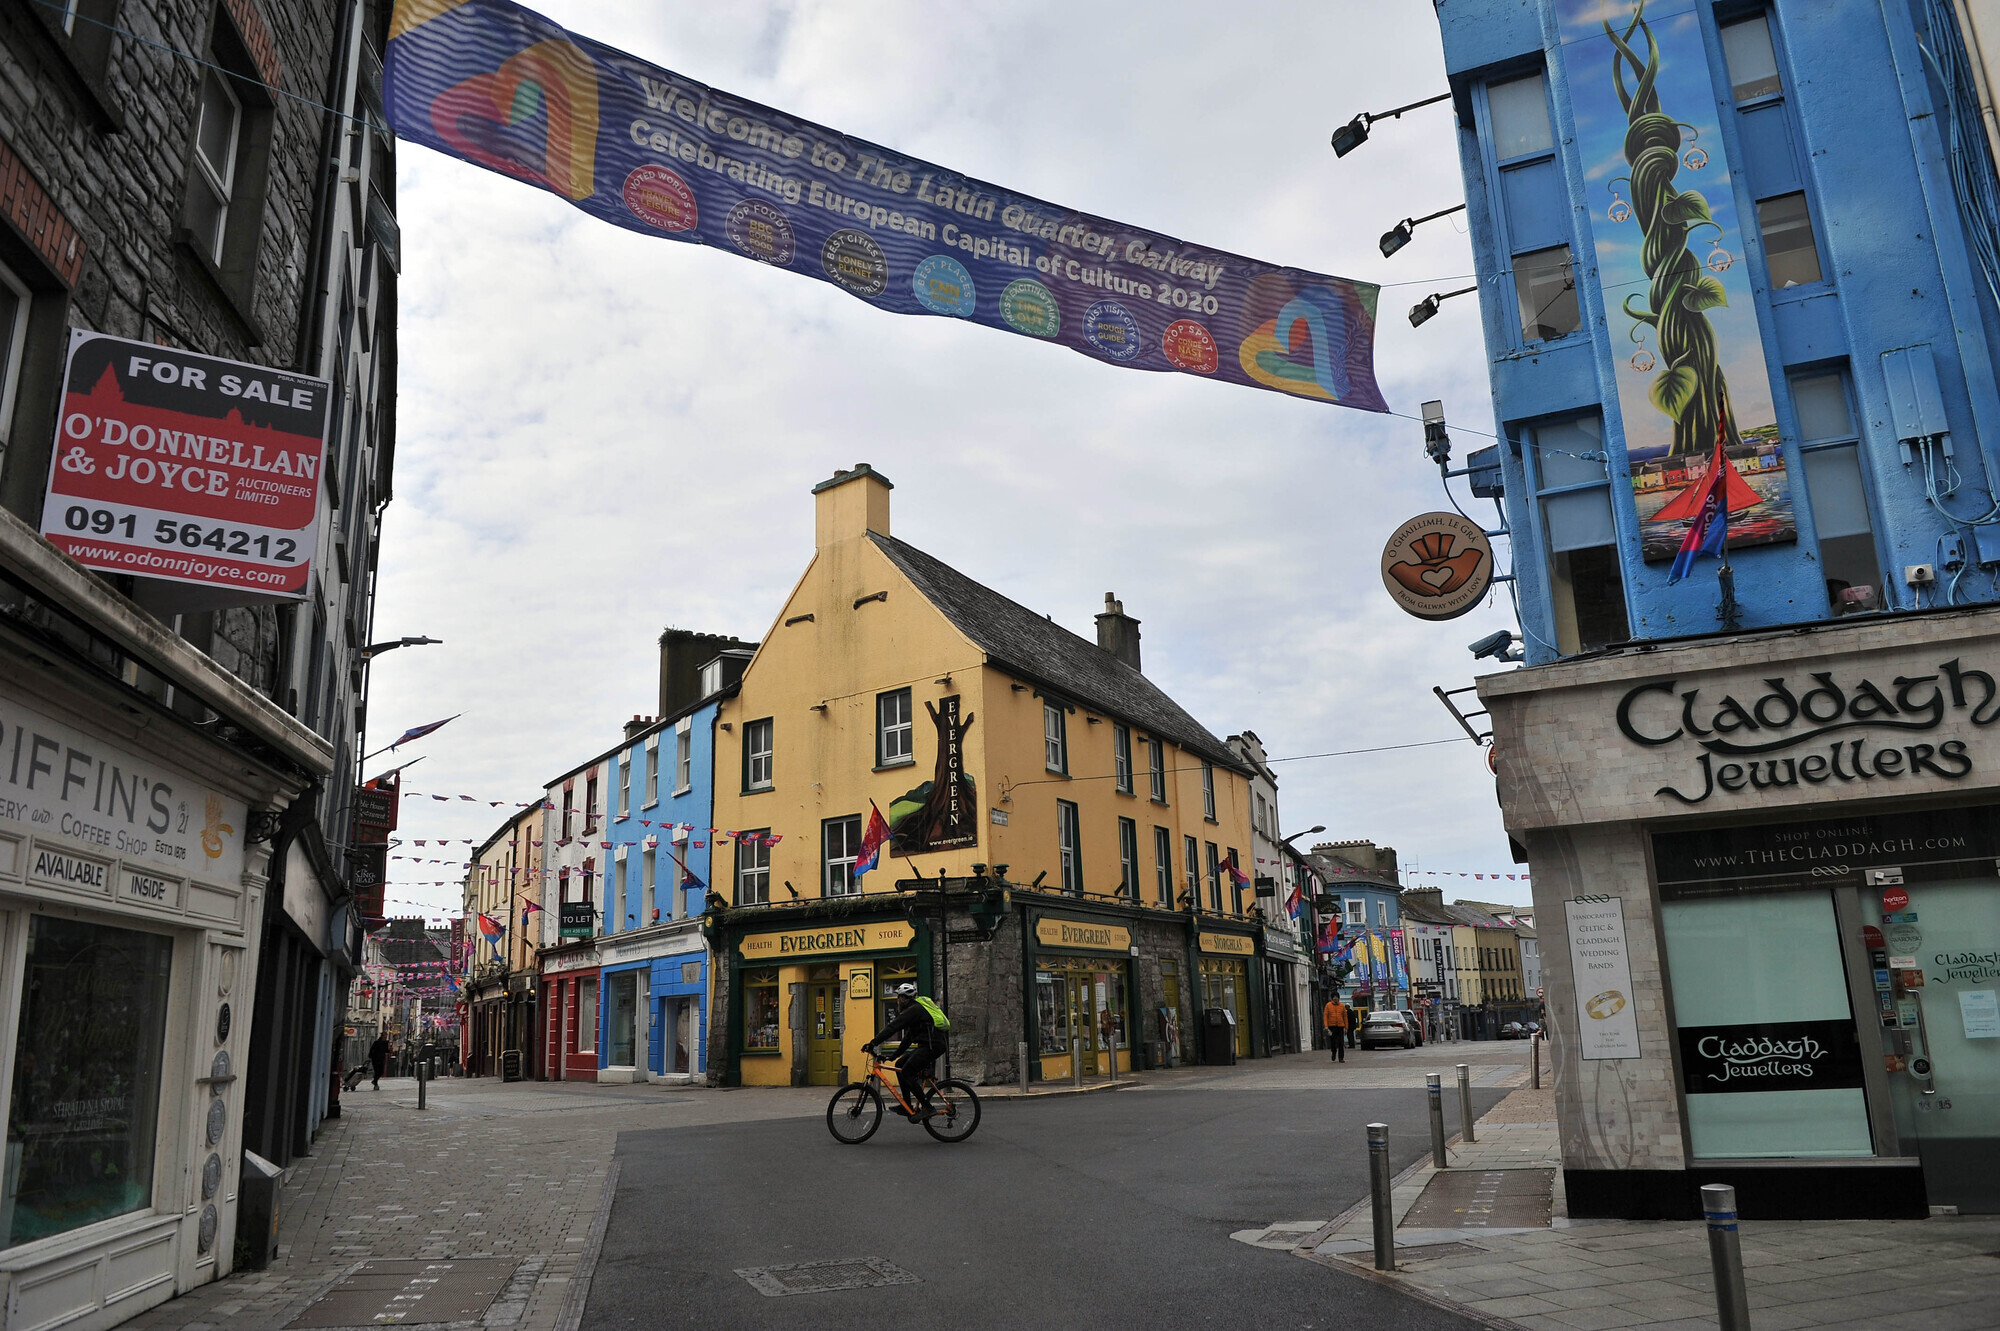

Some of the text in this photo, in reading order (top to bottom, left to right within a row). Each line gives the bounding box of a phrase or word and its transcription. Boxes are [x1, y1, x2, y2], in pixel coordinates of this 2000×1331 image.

[630, 171, 692, 208] VOTED WORLD'S
[640, 75, 1225, 290] Welcome to The Latin Quarter, Galway
[640, 188, 675, 206] TRAVEL
[640, 198, 680, 216] LEISURE
[630, 119, 1219, 315] Celebrating European Capital of Culture 2020
[732, 204, 790, 240] TOP FOODIE
[750, 220, 772, 234] BBC
[748, 230, 772, 243] GOOD
[750, 238, 772, 250] FOOD
[826, 234, 884, 272] BEST CITIES IN
[838, 254, 872, 270] LONELY
[838, 263, 872, 278] PLANET
[918, 260, 971, 298] BEST PLACES
[929, 278, 960, 298] CNN
[1004, 284, 1056, 332] MOST EXCITING THINGS
[1016, 300, 1044, 315] TIME
[1016, 312, 1043, 328] OUT
[1086, 304, 1136, 338] MUST VISIT CITY
[1098, 322, 1126, 335] ROUGH
[1098, 332, 1126, 344] GUIDES
[1166, 324, 1213, 352] TOP SPOT
[1174, 356, 1186, 368] TO
[1178, 345, 1202, 358] NAST
[128, 356, 314, 412] FOR SALE
[64, 413, 318, 480] O'DONNELLAN
[61, 446, 230, 497] & JOYCE
[234, 489, 280, 506] LIMITED
[236, 476, 313, 498] AUCTIONEERS
[64, 505, 297, 563] 091 564212
[1448, 518, 1458, 528] LE
[67, 542, 287, 586] www.odonnjoyce.com
[1398, 590, 1416, 606] FROM
[1418, 600, 1446, 610] GALWAY
[1448, 594, 1468, 606] WITH
[1616, 657, 2000, 754] Claddagh
[948, 701, 959, 826] EVERGREEN
[1654, 738, 1973, 801] Jewellers
[0, 720, 173, 835] IFFIN'S
[60, 812, 112, 846] COFFEE
[116, 830, 148, 856] SHOP
[1775, 826, 1873, 843] SHOP ONLINE:
[34, 852, 166, 900] AVAILABLE INSIDE
[562, 916, 574, 924] TO
[1573, 912, 1618, 920] HANDCRAFTED
[1061, 924, 1112, 946] EVERGREEN
[1579, 924, 1606, 932] CELTIC
[747, 928, 903, 953] HEALTH EVERGREEN STORE
[1576, 937, 1620, 945] CLADDAGH
[1588, 962, 1614, 970] BANDS
[1698, 1034, 1828, 1064] Claddagh
[1708, 1060, 1814, 1083] Jewellers
